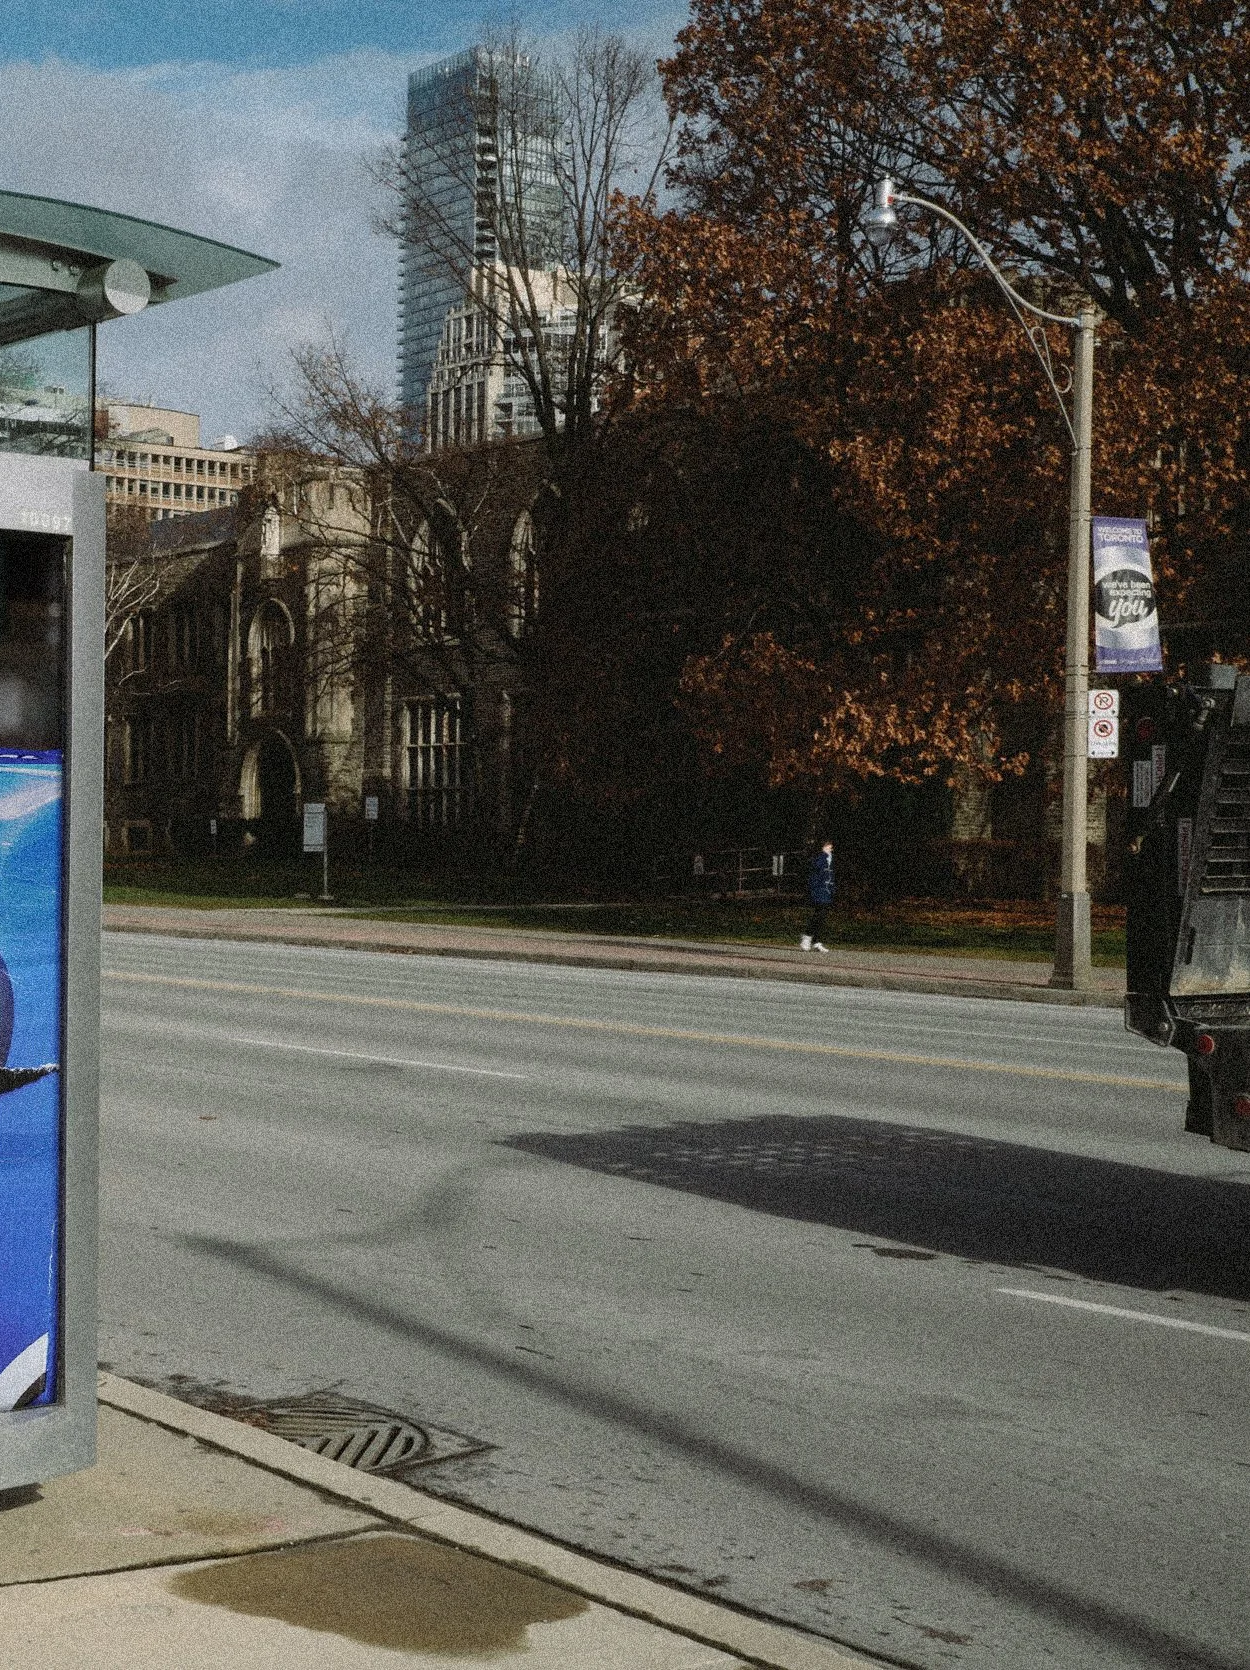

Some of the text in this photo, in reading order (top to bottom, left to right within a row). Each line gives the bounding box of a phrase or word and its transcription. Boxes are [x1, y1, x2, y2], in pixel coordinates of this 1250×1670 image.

[1097, 534, 1144, 543] TORONTO
[1130, 580, 1150, 589] been
[1109, 588, 1152, 598] expecting
[1108, 598, 1149, 625] you
